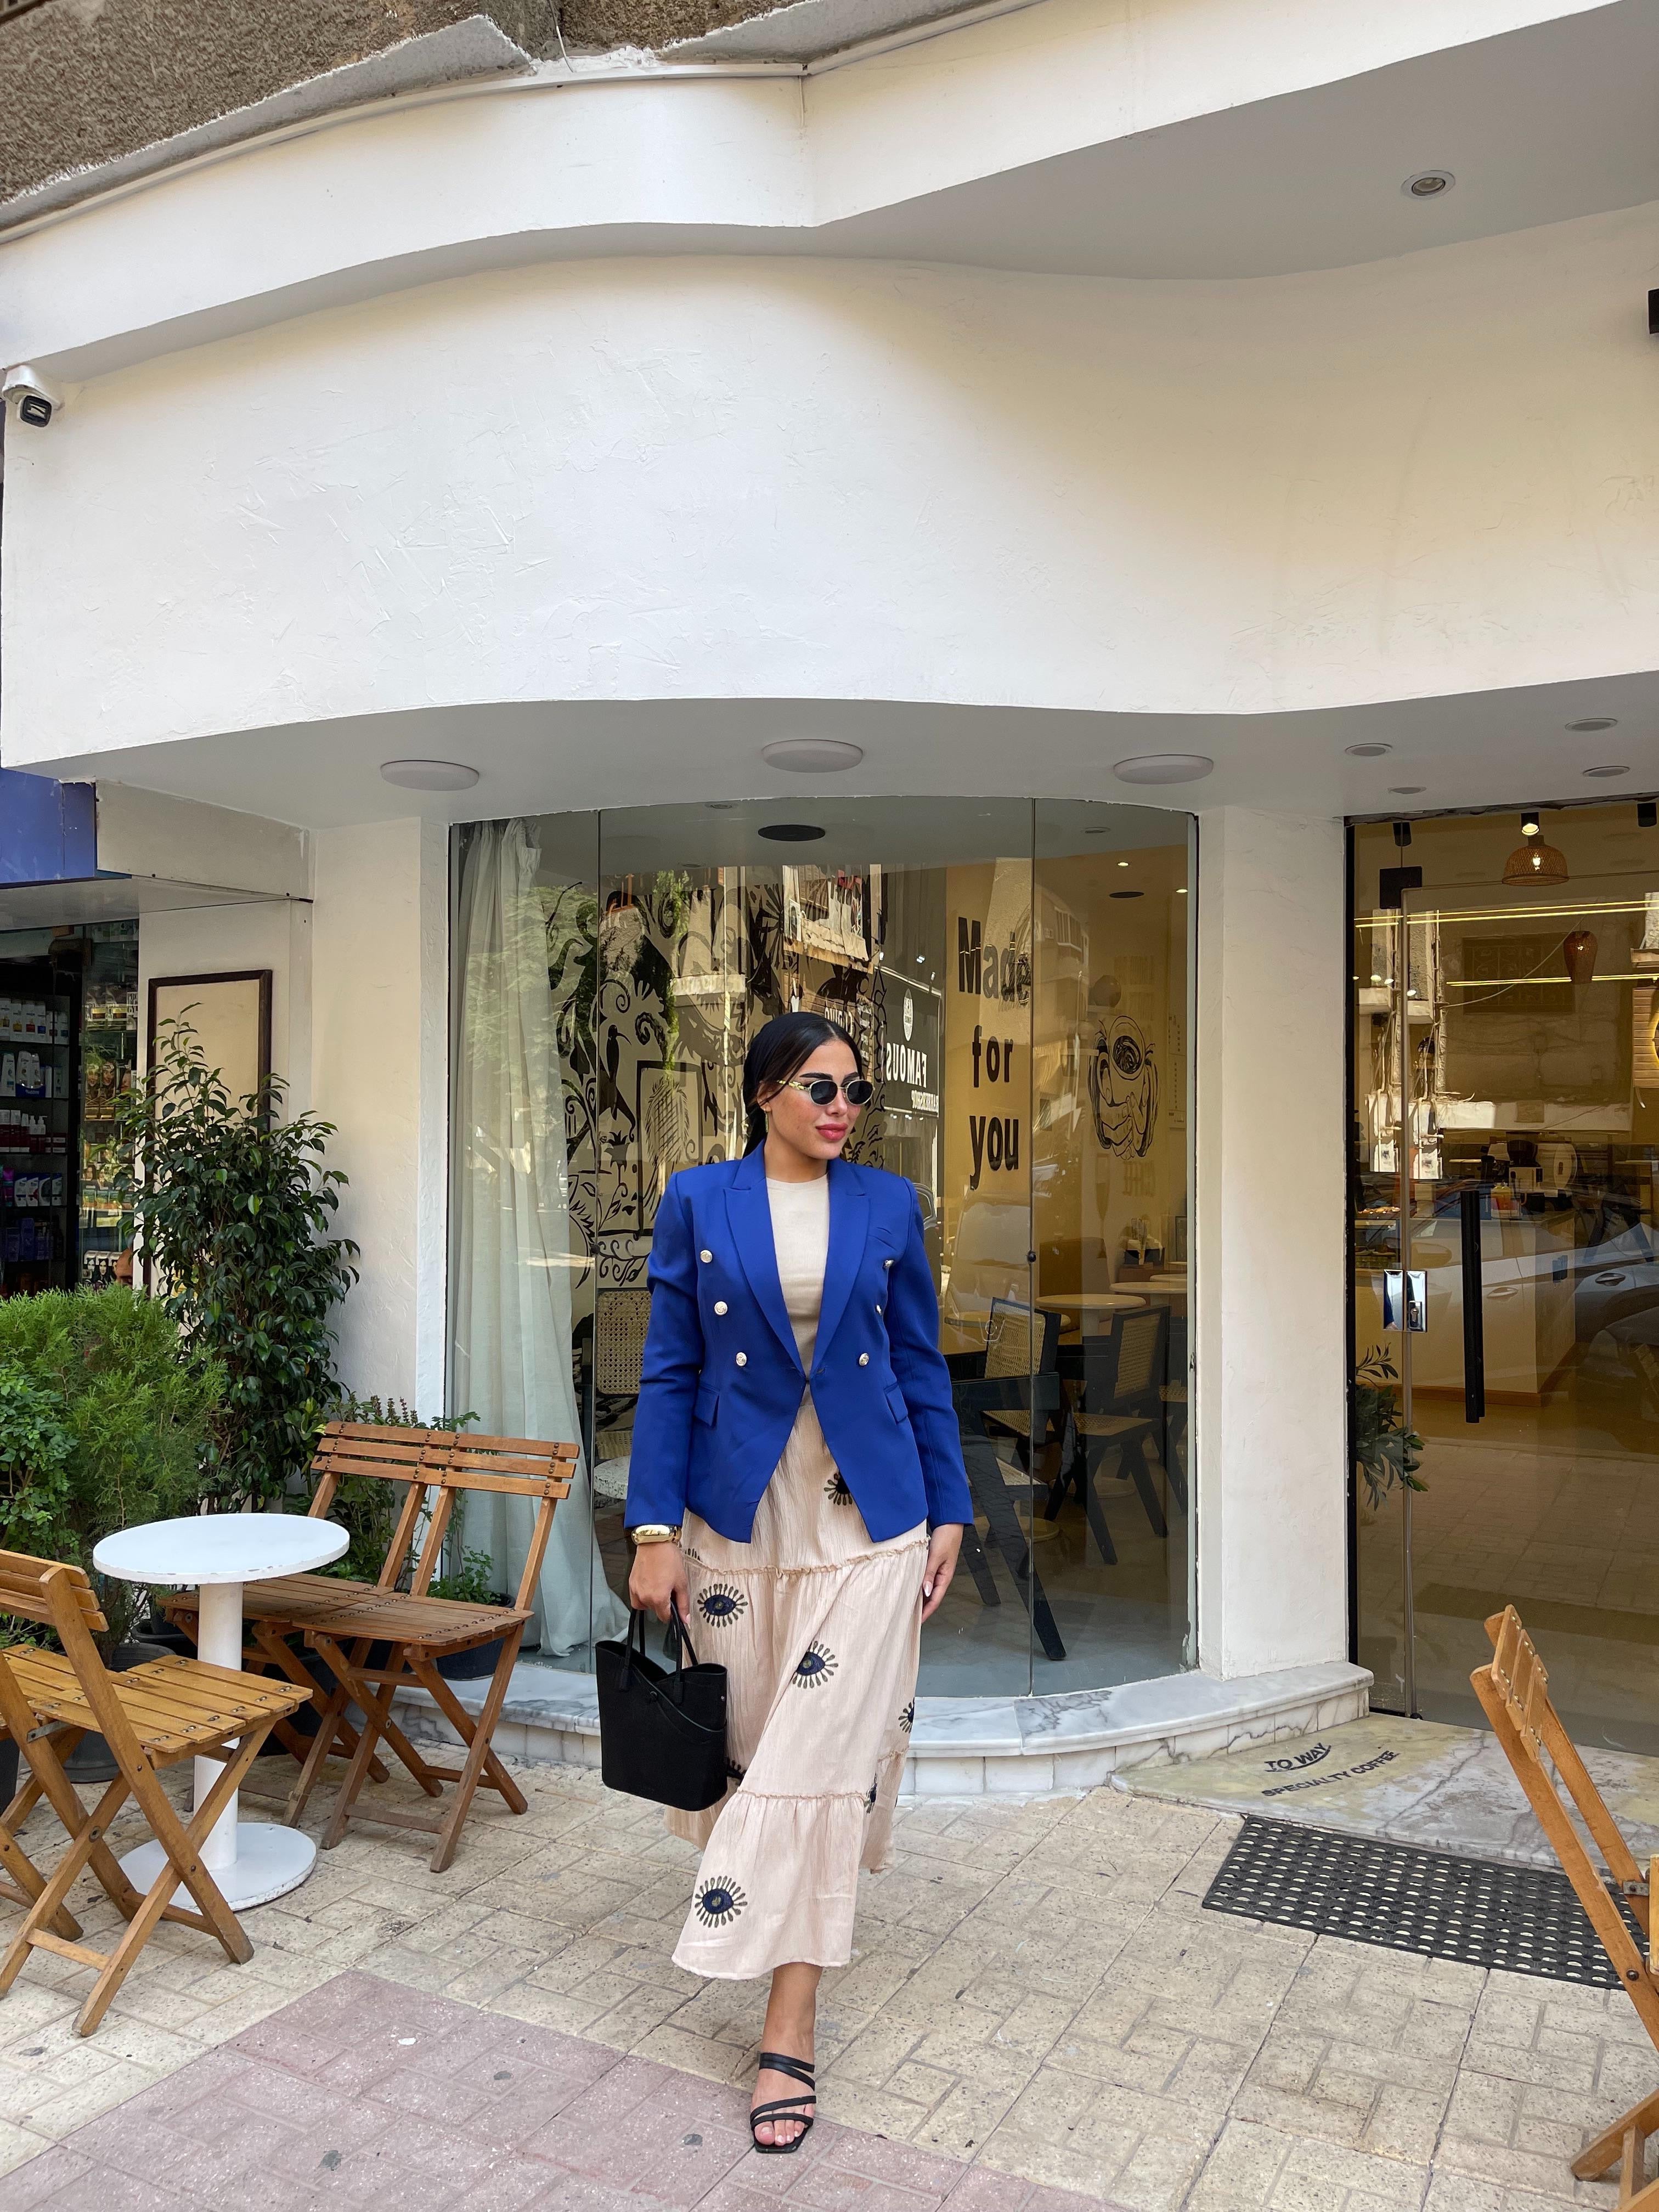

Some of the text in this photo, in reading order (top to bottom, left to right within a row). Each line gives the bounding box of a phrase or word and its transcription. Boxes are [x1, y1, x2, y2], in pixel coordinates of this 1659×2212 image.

[958, 917, 1031, 1006] Made
[972, 1024, 1014, 1088] for
[969, 1115, 1019, 1191] you
[1262, 1750, 1401, 1797] SPECIALTY COFFEE
[1264, 1742, 1328, 1771] TO WAY
